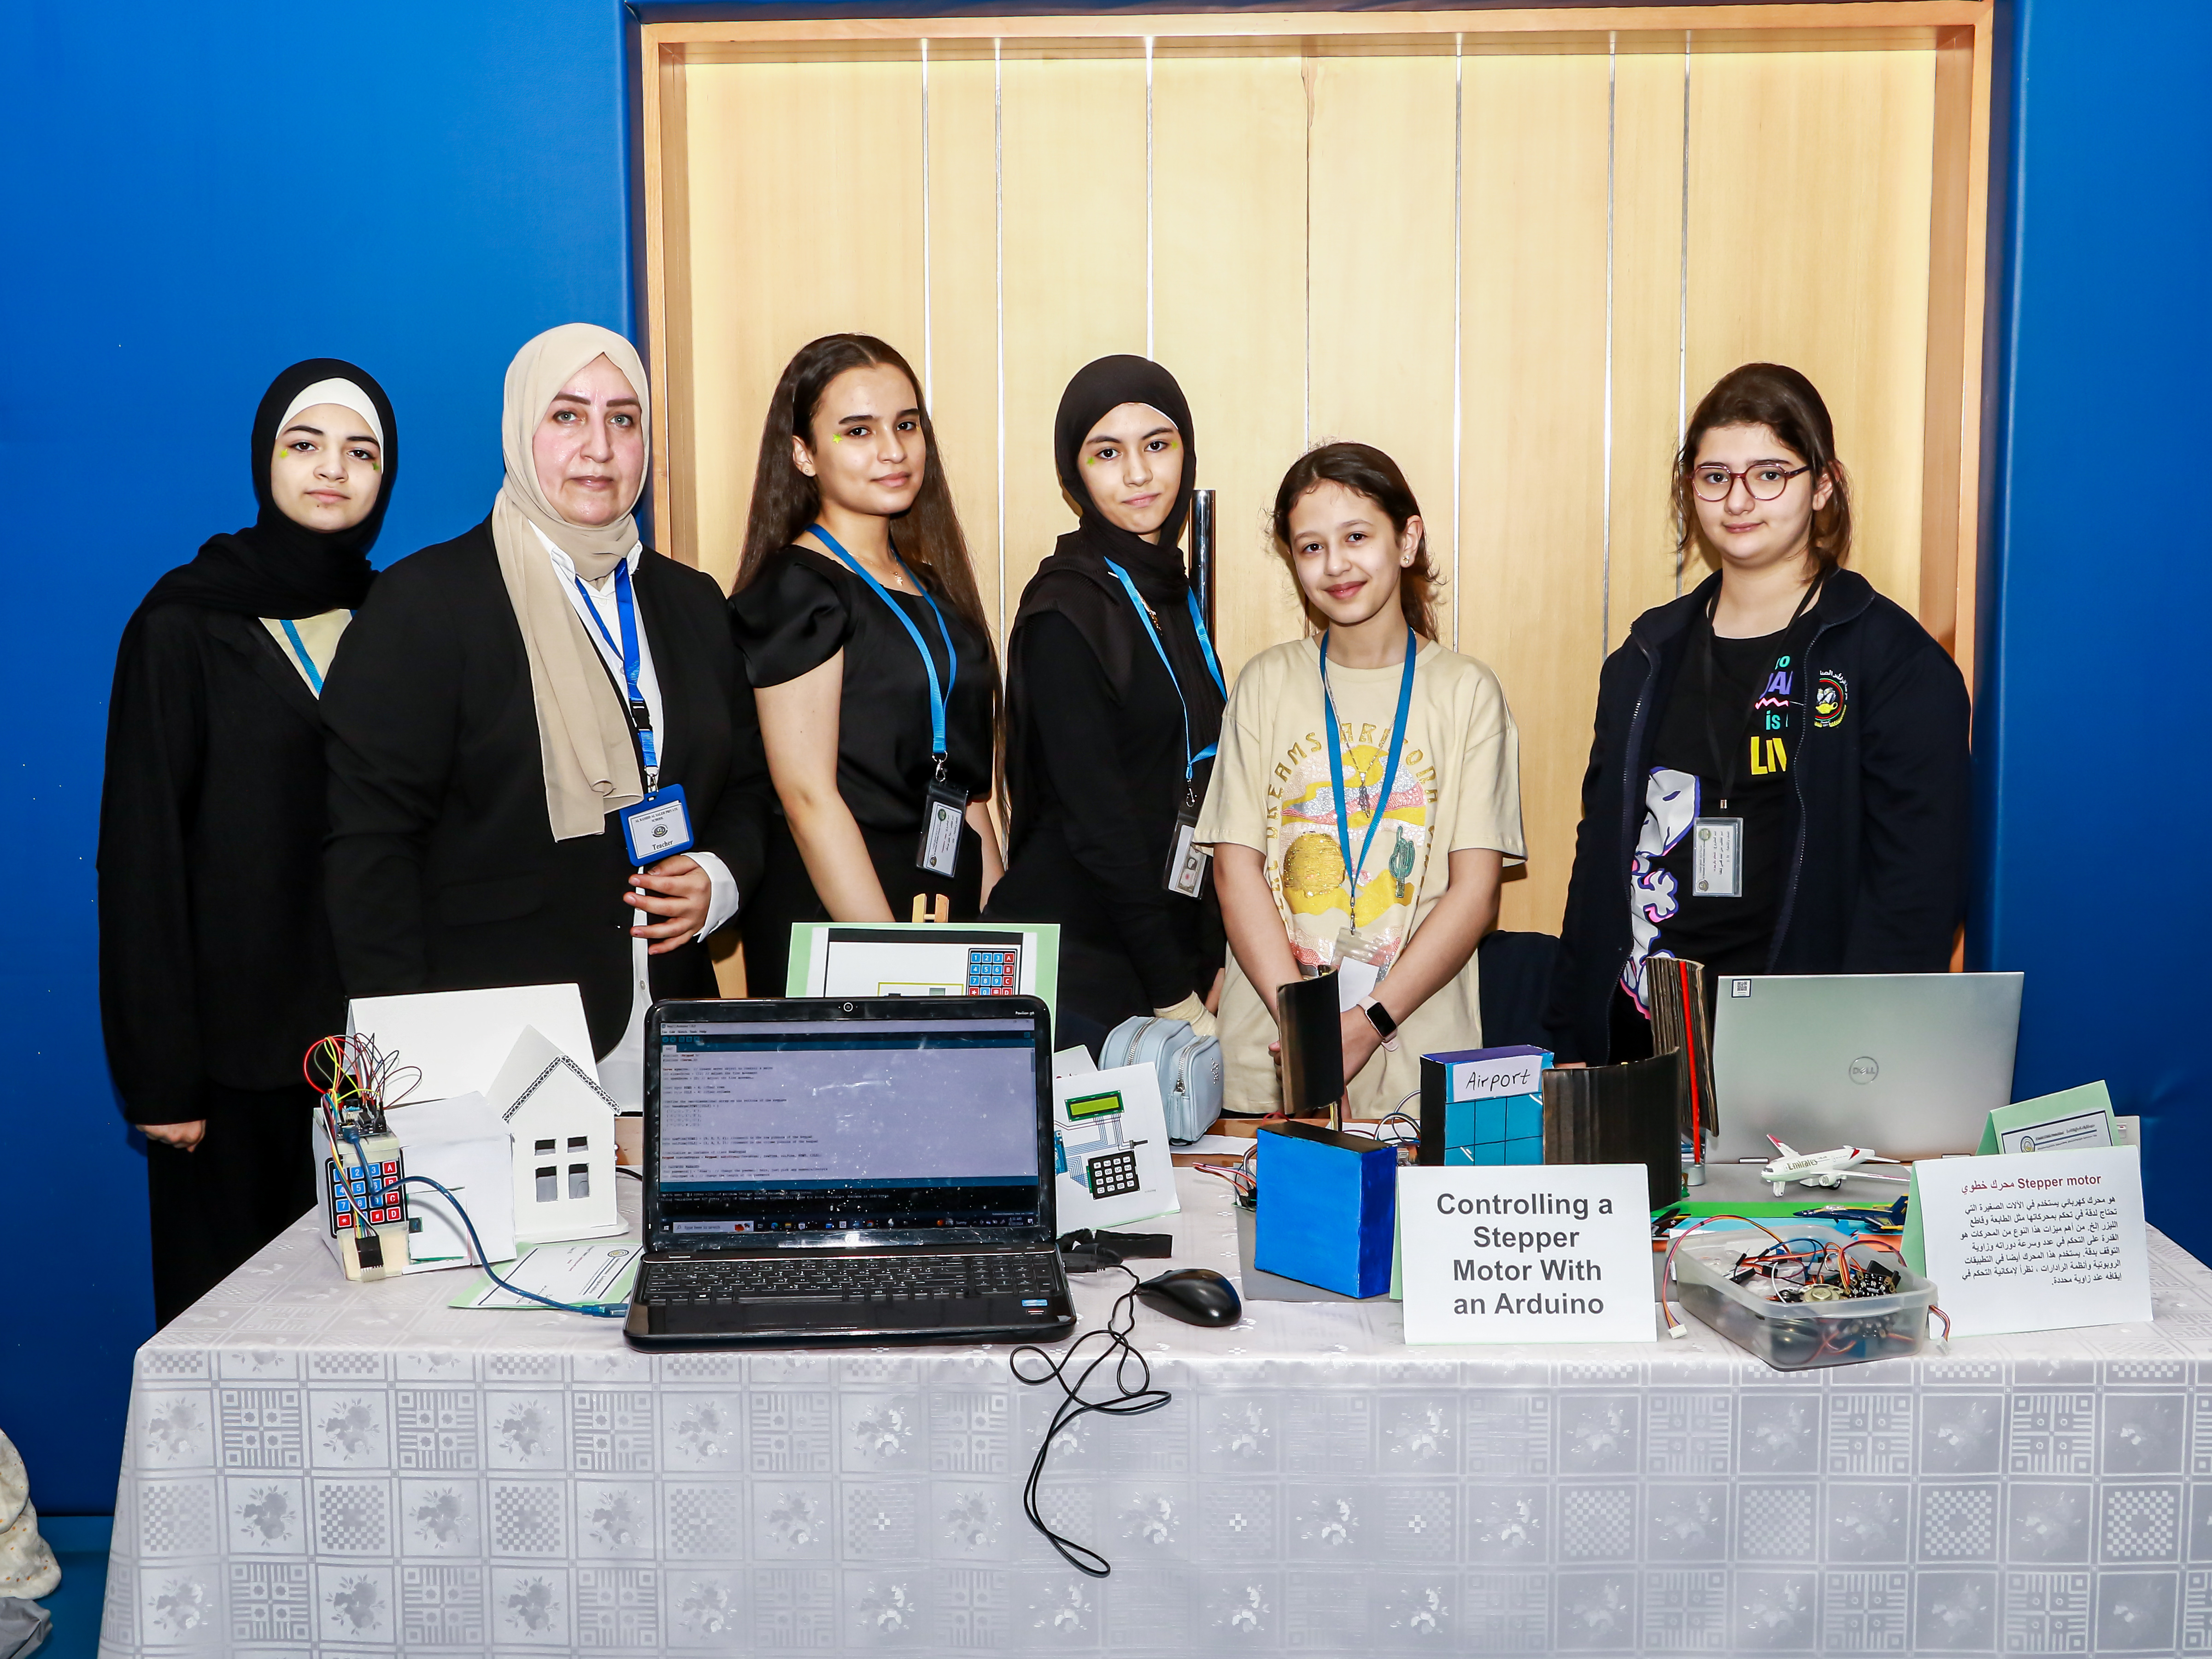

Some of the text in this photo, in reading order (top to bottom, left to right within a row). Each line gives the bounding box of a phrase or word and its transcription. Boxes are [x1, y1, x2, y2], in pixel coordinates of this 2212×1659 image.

[1766, 710, 1781, 730] is
[652, 840, 673, 850] Teacher
[1466, 1069, 1531, 1091] Airport
[1787, 1158, 1818, 1170] Emirates
[1961, 1179, 2015, 1195] محرك خطوي
[2018, 1175, 2101, 1190] Stepper motor
[2026, 1199, 2035, 1210] في
[2037, 1200, 2059, 1209] يستخدم
[2087, 1197, 2106, 1205] محرك
[1437, 1193, 1613, 1220] Controlling a
[1965, 1204, 1977, 1214] التي
[1979, 1202, 2004, 1212] الصغيرة
[2014, 1213, 2025, 1223] مثل
[2027, 1213, 2057, 1223] بمحركاتها
[2059, 1211, 2073, 1221] تحكم
[2075, 1209, 2083, 1220] في
[2100, 1208, 2117, 1219] تحتاج
[1970, 1216, 1989, 1228] وقاطع
[1990, 1215, 2012, 1224] الطابعة
[2043, 1225, 2062, 1234] ميزات
[2102, 1220, 2118, 1231] الليزر
[1960, 1232, 1968, 1240] هو
[1971, 1229, 2000, 1238] المحركات
[2013, 1227, 2029, 1237] النوع
[1474, 1226, 1580, 1253] Stepper
[2056, 1236, 2065, 1248] في
[2067, 1236, 2085, 1247] التحكم
[2087, 1235, 2099, 1245] على
[2102, 1234, 2119, 1243] القدرة
[1972, 1242, 1994, 1252] وزاوية
[2018, 1239, 2041, 1249] وسرعة
[2059, 1250, 2081, 1260] يستخدم
[2100, 1246, 2120, 1255] التوقف
[1965, 1255, 1993, 1265] التطبيقات
[1995, 1253, 2004, 1265] في
[2023, 1251, 2044, 1261] المحرك
[2093, 1259, 2121, 1269] الروبوتية
[1454, 1259, 1602, 1281] Motor With
[1962, 1269, 1971, 1280] في
[1973, 1268, 1992, 1279] التحكم
[2074, 1274, 2091, 1284] زاوية
[1454, 1293, 1604, 1314] an Arduino
